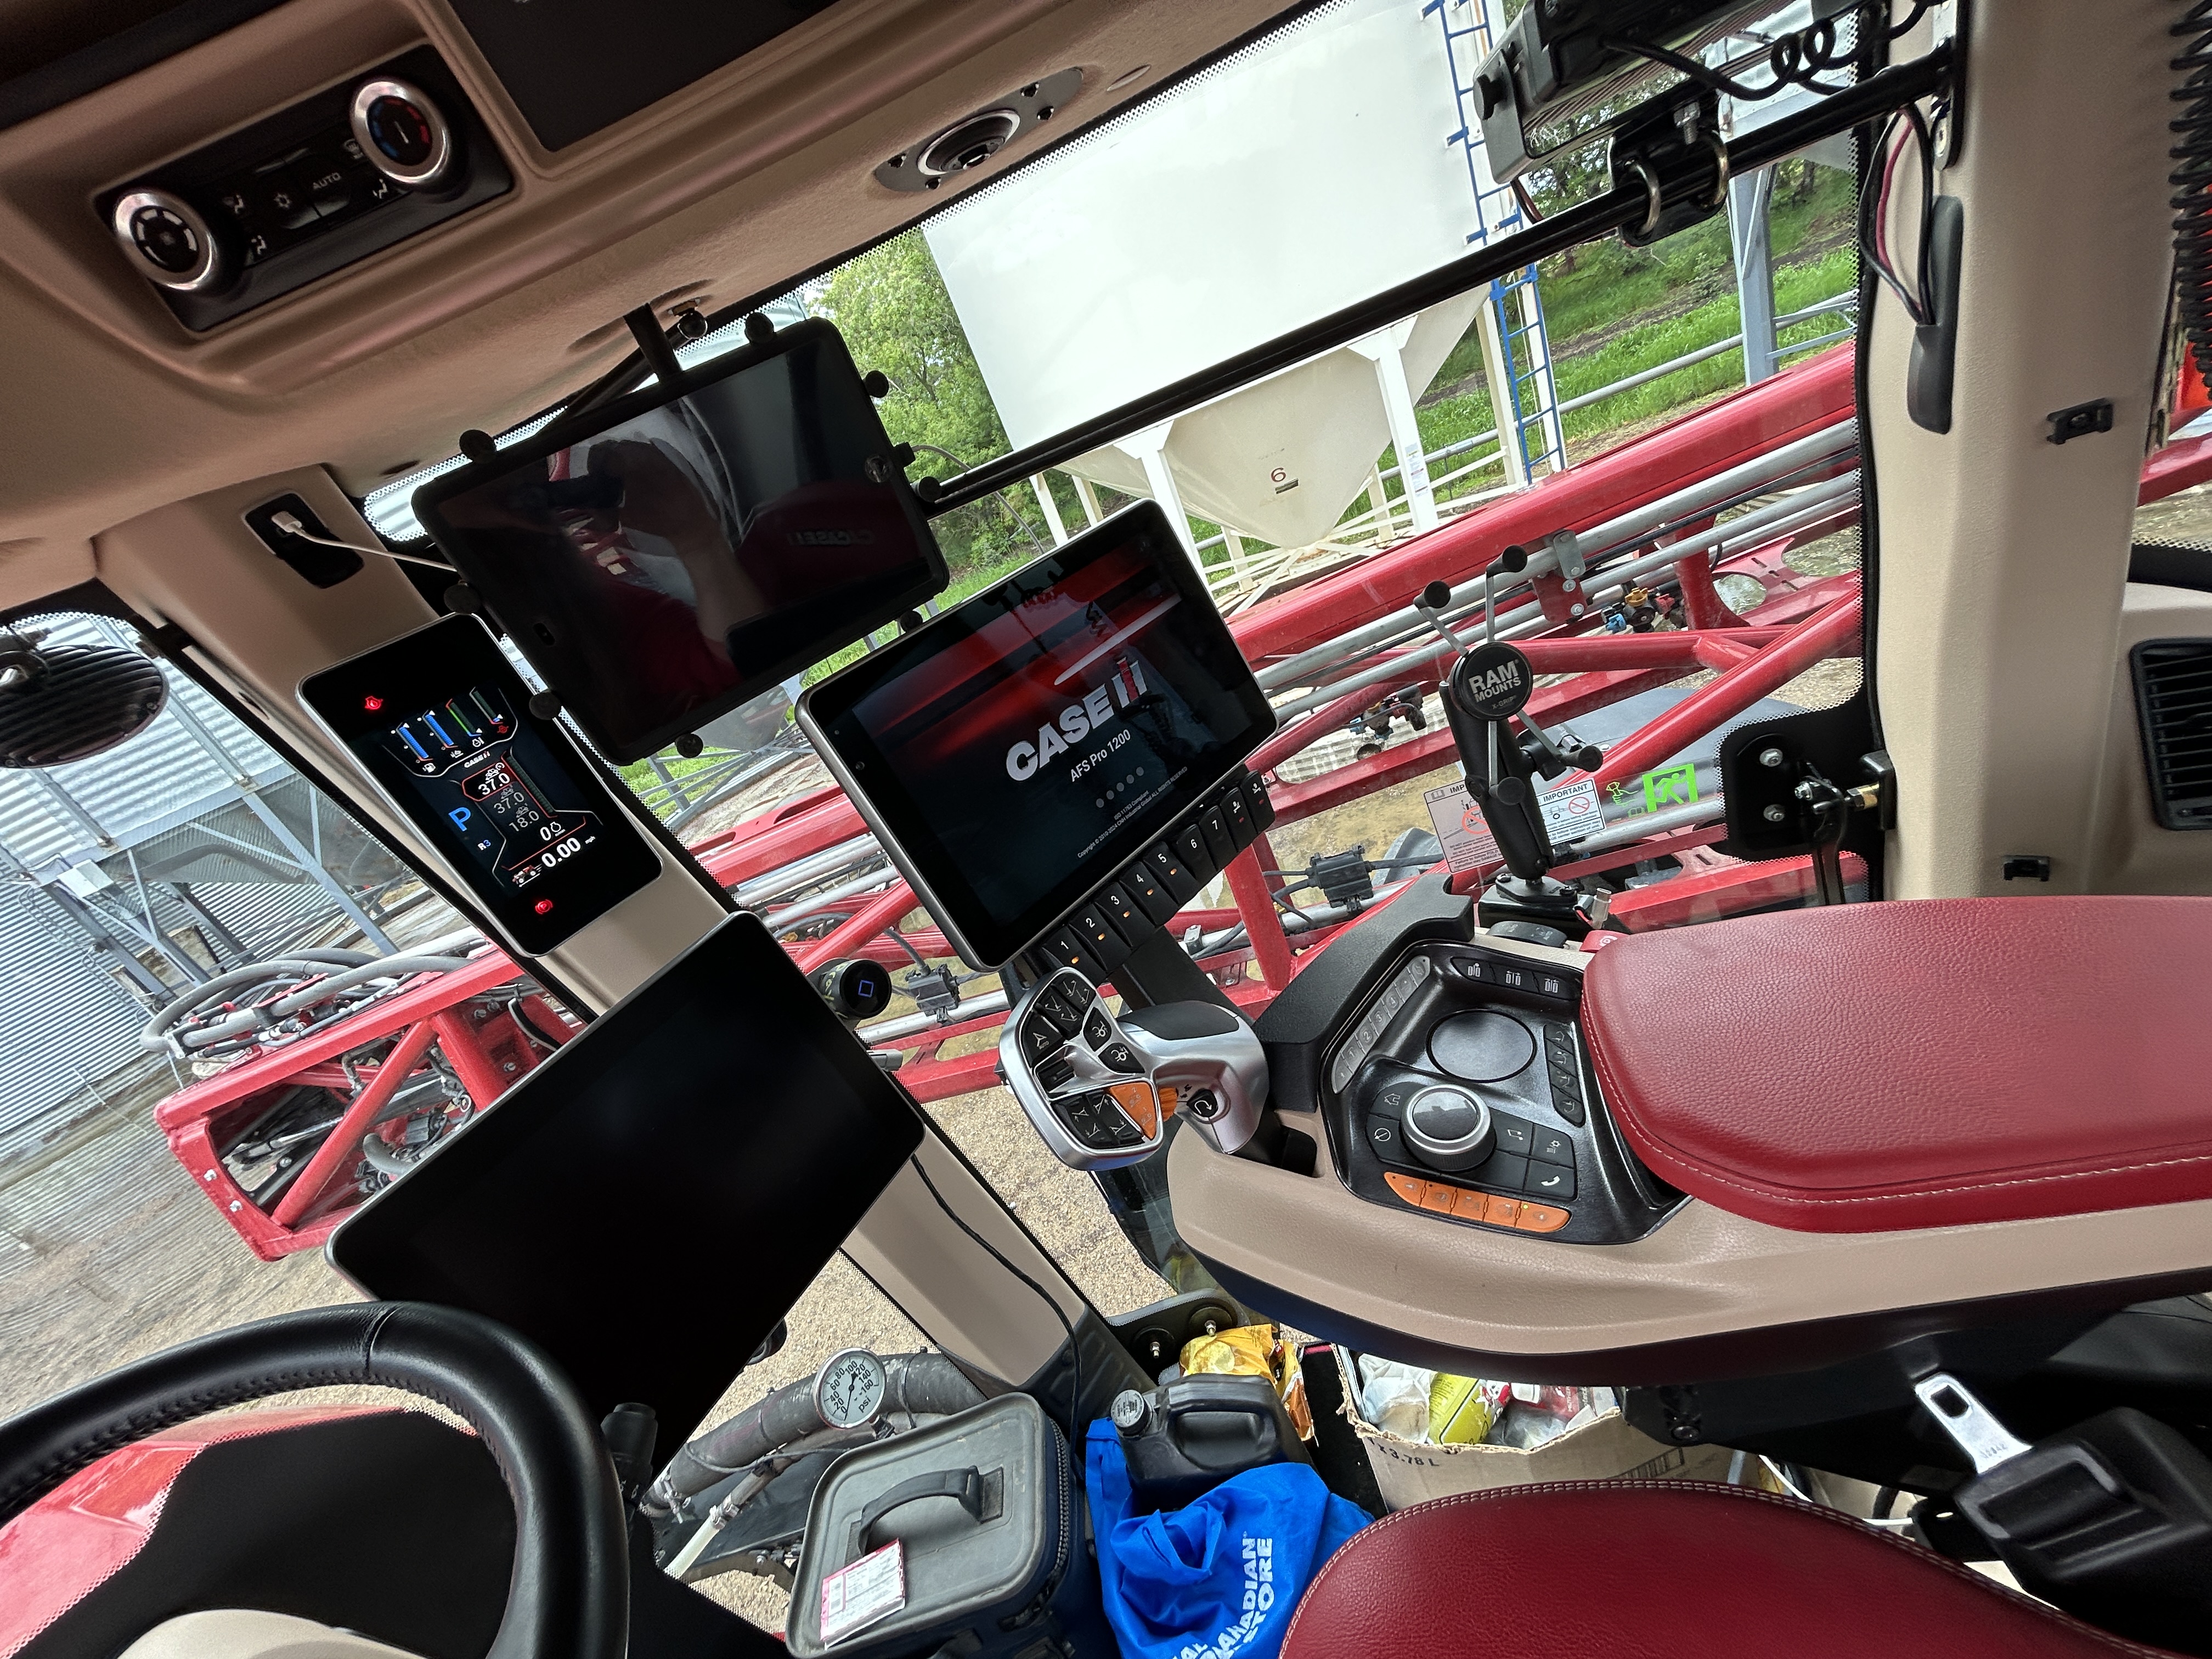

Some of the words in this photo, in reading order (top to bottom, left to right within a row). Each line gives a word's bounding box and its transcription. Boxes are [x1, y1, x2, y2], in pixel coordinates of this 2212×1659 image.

[313, 172, 342, 190] AUTO
[1271, 467, 1286, 482] 6
[1469, 661, 1519, 694] RAM
[1474, 677, 1521, 702] MOUNTS
[1492, 696, 1514, 709] X-GRIP
[1006, 684, 1114, 781] CASE
[464, 754, 484, 768] CASE
[1070, 760, 1090, 782] AFS
[1090, 749, 1107, 766] Pro
[1108, 729, 1131, 752] 1200
[478, 773, 510, 795] 37.0
[1130, 789, 1149, 806] Compliant
[1543, 783, 1588, 802] IMPORTANT
[494, 792, 524, 814] 37.0
[448, 806, 471, 831] P
[1076, 841, 1097, 859] Copyright
[1156, 779, 1171, 792] RIGHTS
[1169, 766, 1188, 782] RESERVED
[509, 811, 539, 832] 18.0
[1212, 820, 1218, 830] 7
[540, 827, 551, 841] 0
[477, 840, 492, 851] R3
[1190, 839, 1197, 849] 6
[541, 838, 581, 867] 0.00
[1158, 853, 1167, 864] 5
[1136, 873, 1144, 883] 4
[1110, 895, 1120, 906] 3
[1086, 917, 1096, 928] 2
[1061, 940, 1070, 950] 1
[1376, 1013, 1383, 1023] 3
[1364, 1032, 1370, 1040] 2
[835, 1368, 845, 1380] 80
[845, 1361, 857, 1375] 100
[854, 1363, 866, 1376] 20
[859, 1369, 871, 1384] 140
[830, 1379, 840, 1391] 60
[861, 1379, 873, 1393] 160
[830, 1391, 840, 1402] 40
[834, 1397, 844, 1410] 20
[840, 1406, 847, 1414] 0
[858, 1395, 871, 1413] psi
[1389, 1448, 1424, 1465] 3.78
[1429, 1458, 1440, 1466] L
